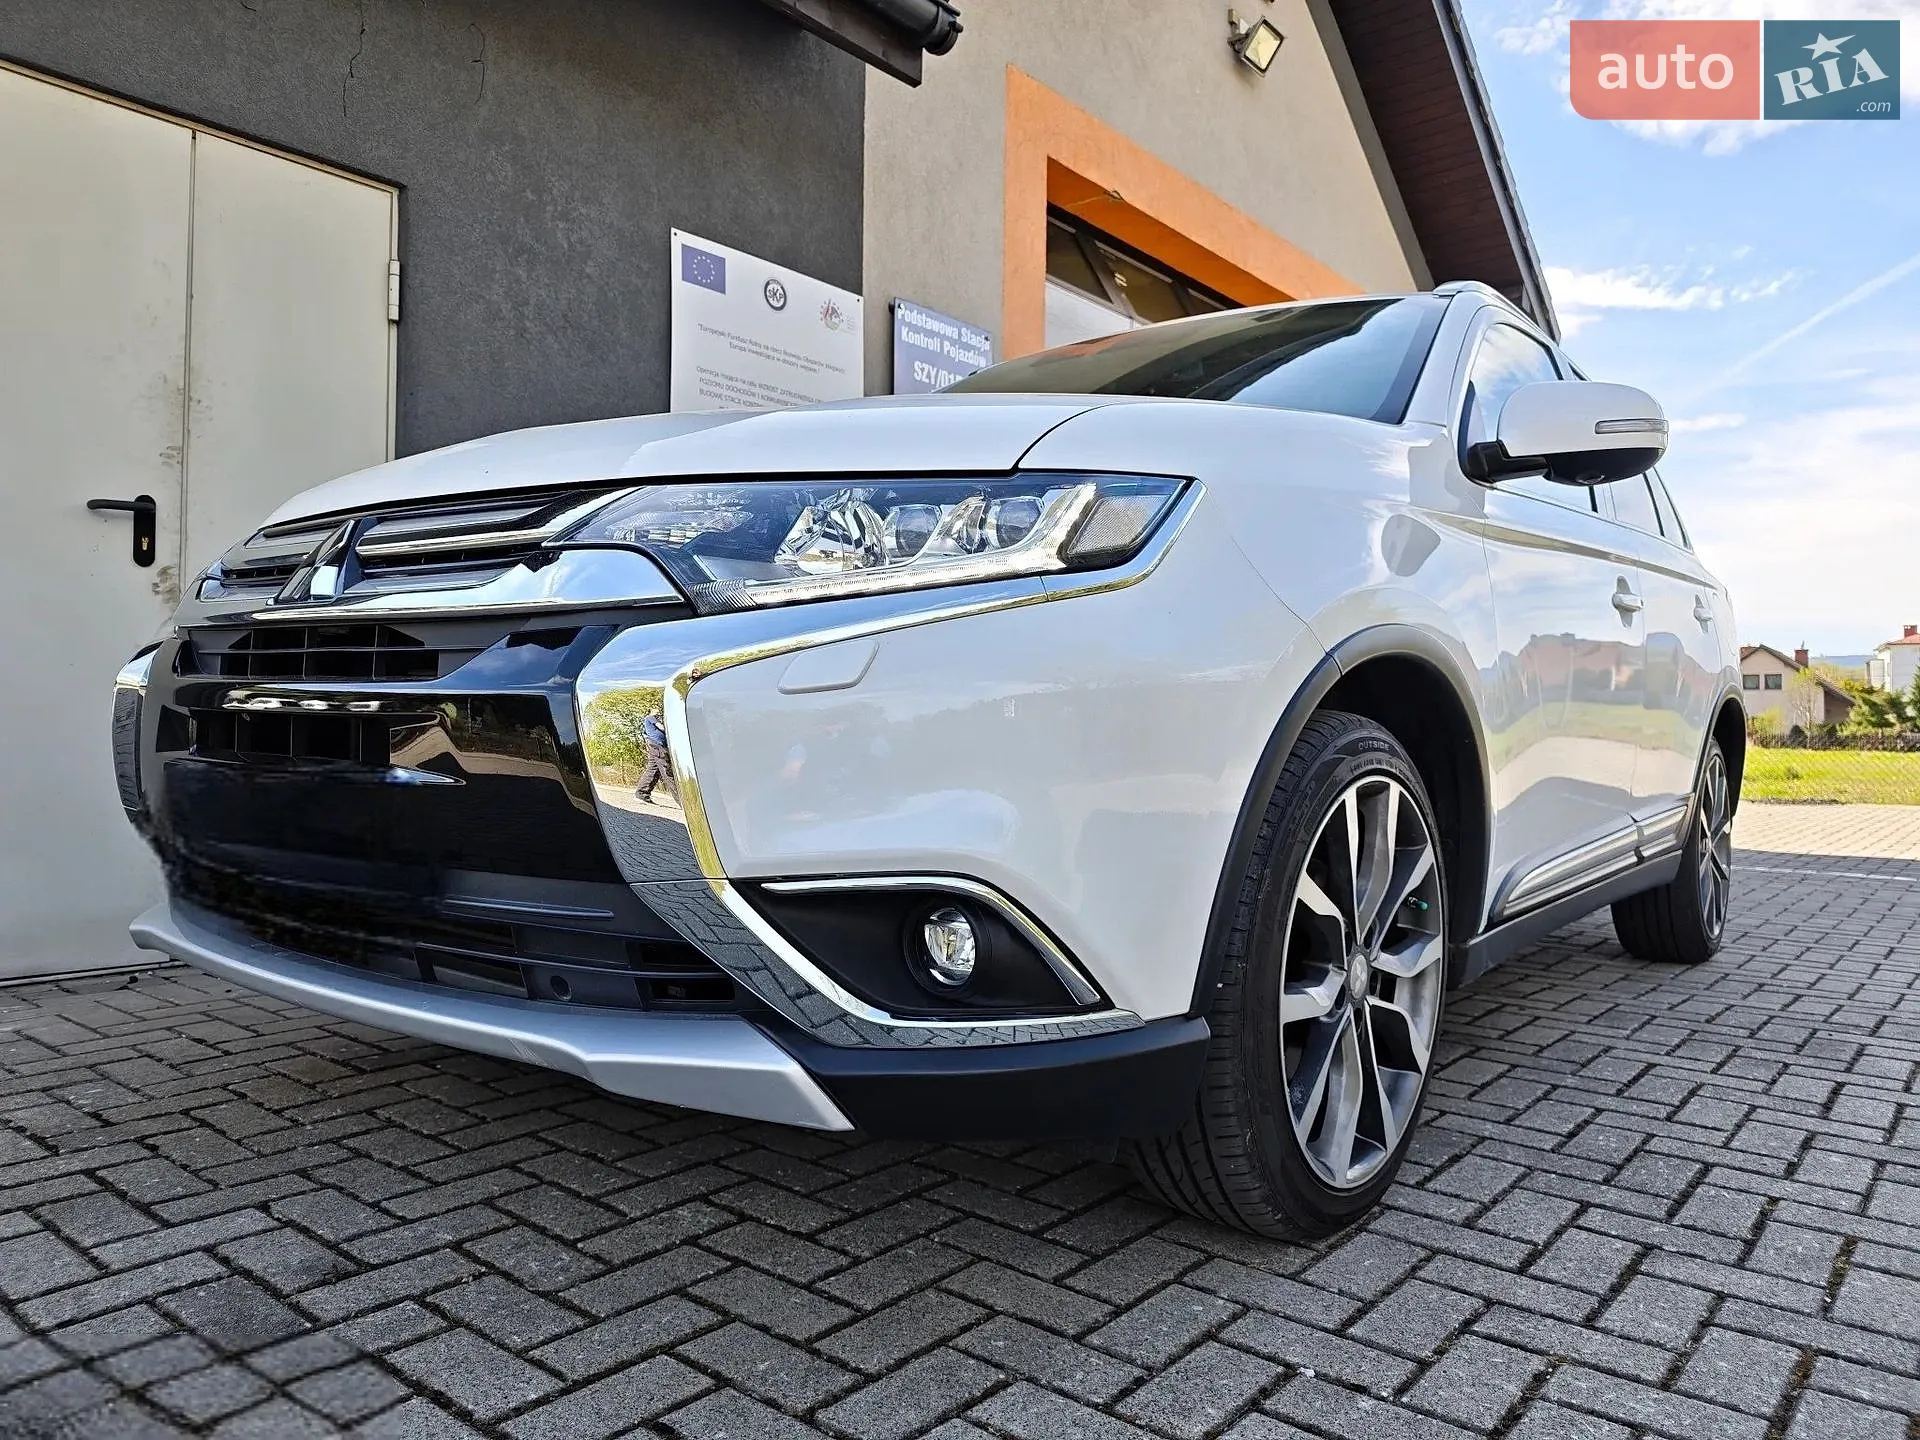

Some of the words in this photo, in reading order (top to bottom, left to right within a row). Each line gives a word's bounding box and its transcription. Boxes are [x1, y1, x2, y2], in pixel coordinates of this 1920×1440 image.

[897, 303, 959, 340] Podstawowa
[961, 327, 990, 351] Stacja
[901, 326, 941, 353] Kontroli
[943, 340, 987, 368] Pojazdów
[1358, 739, 1390, 751] OUTSIDE
